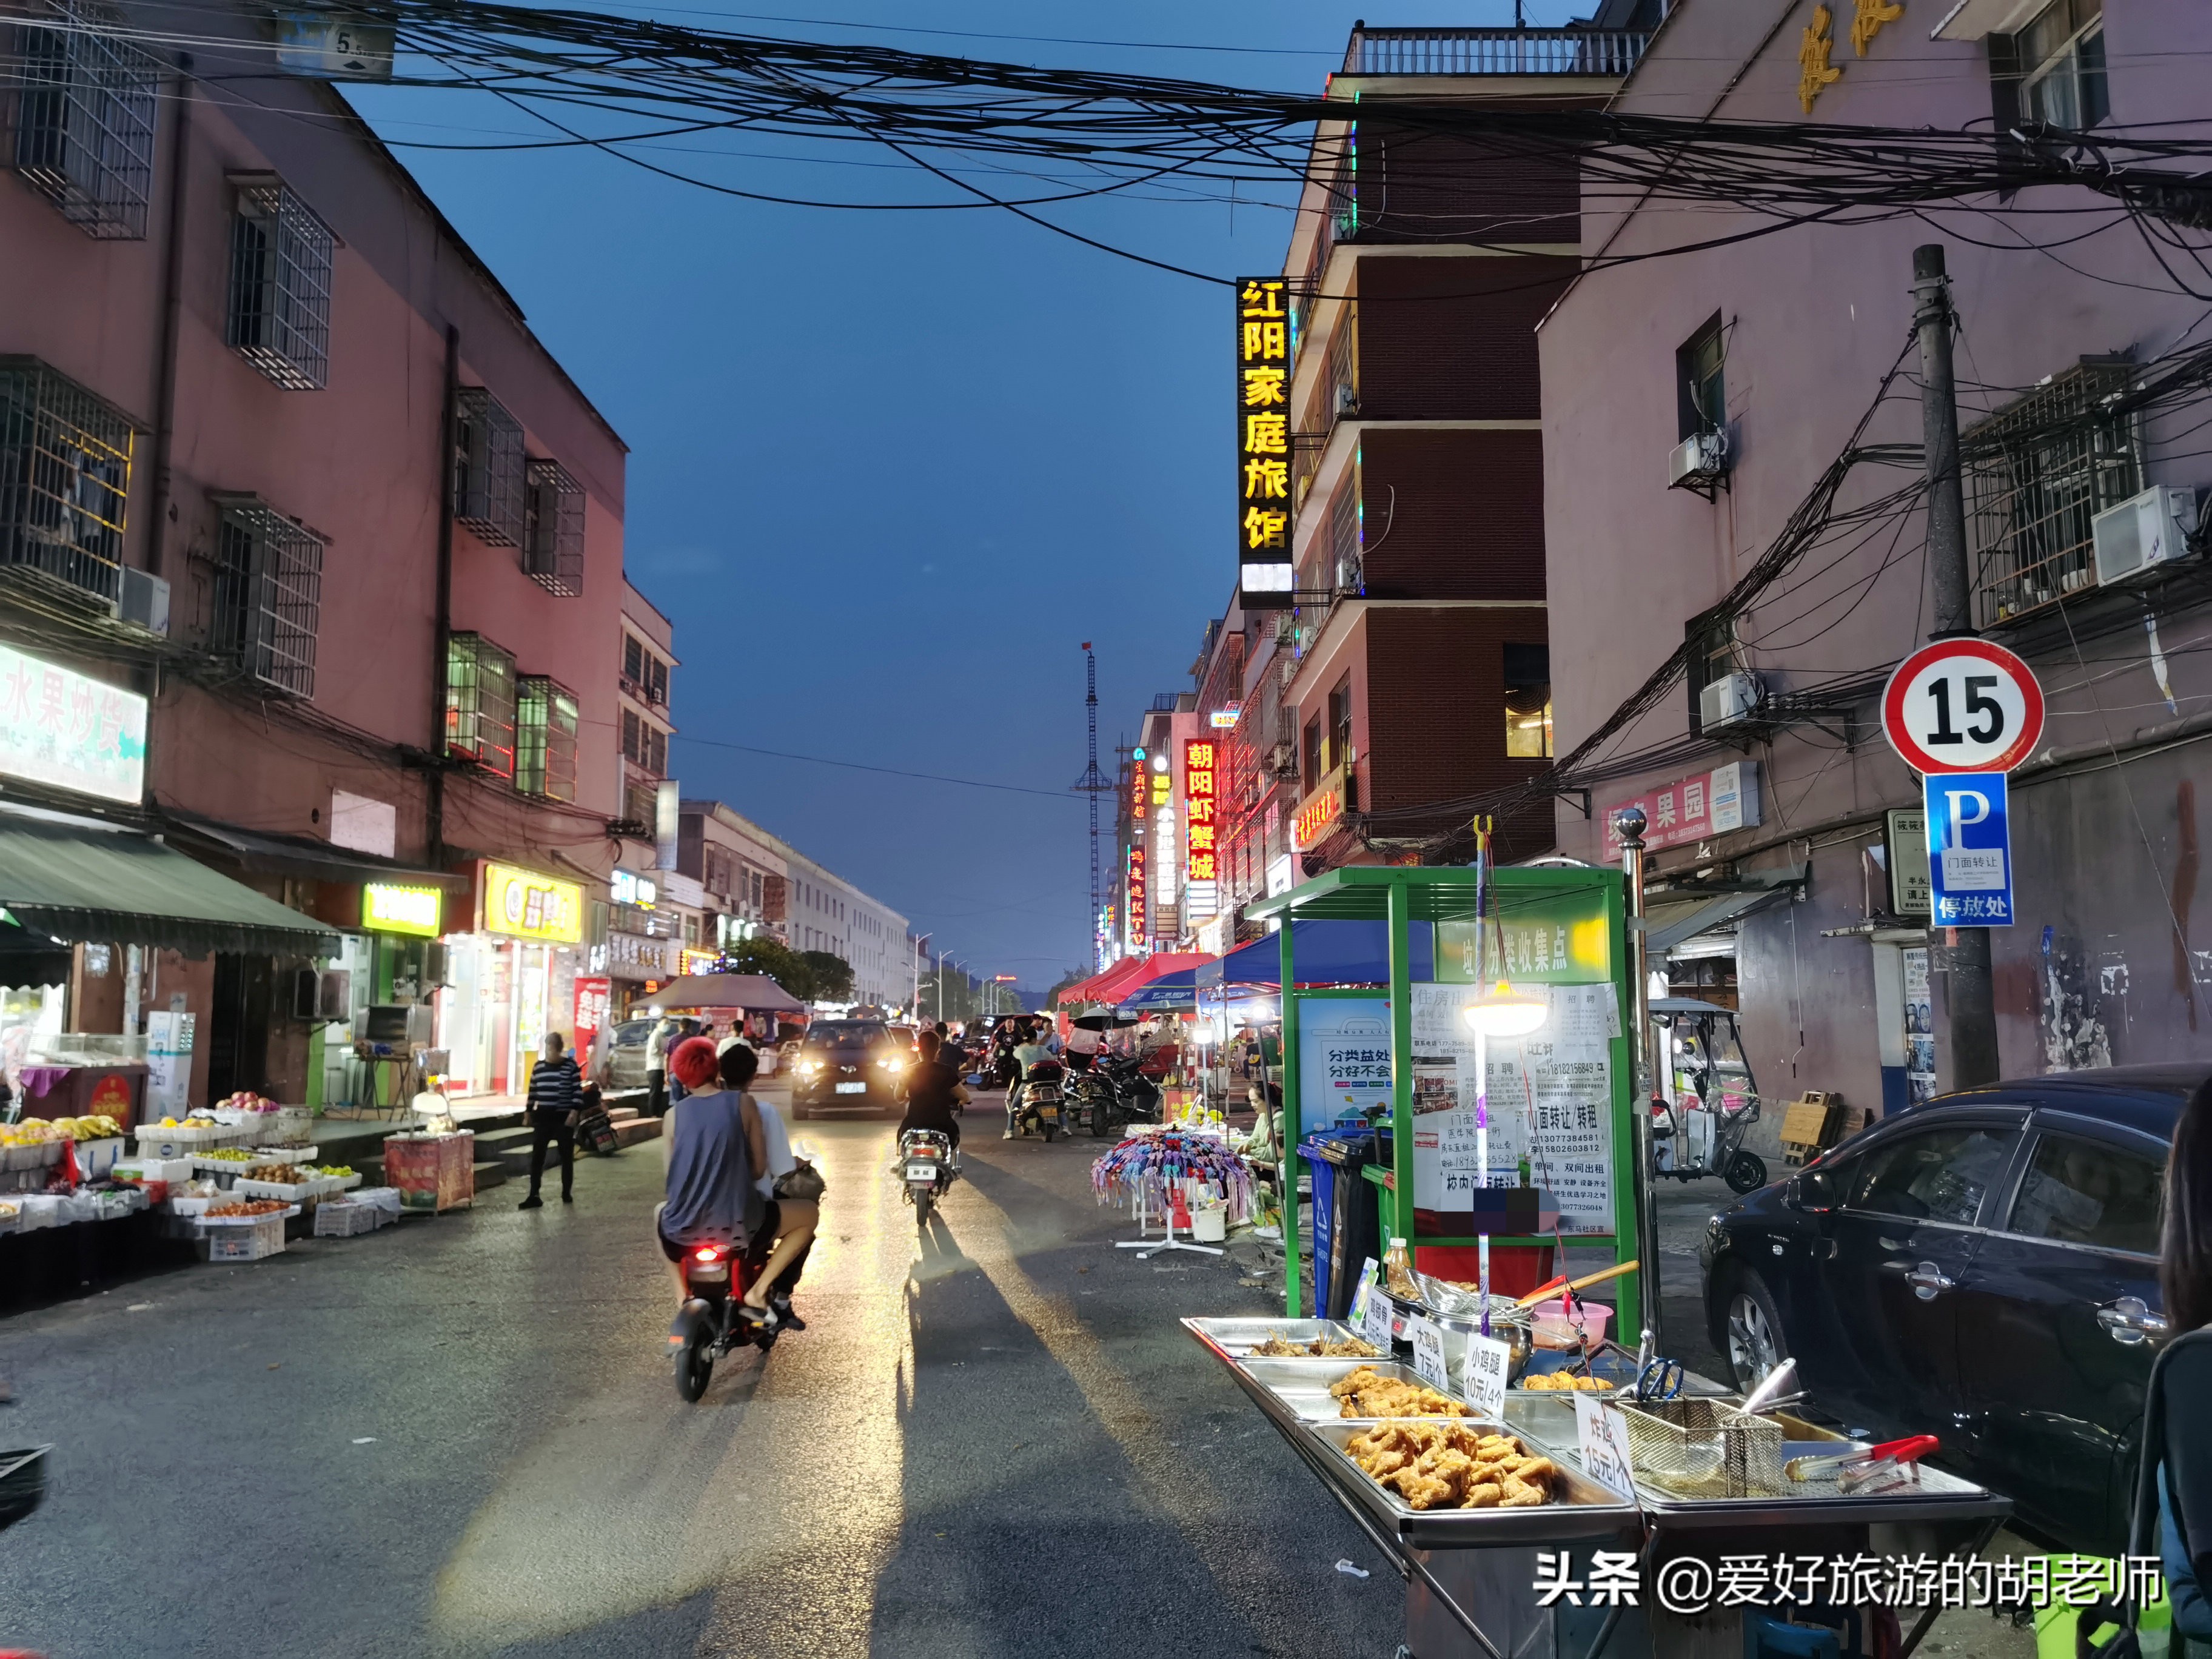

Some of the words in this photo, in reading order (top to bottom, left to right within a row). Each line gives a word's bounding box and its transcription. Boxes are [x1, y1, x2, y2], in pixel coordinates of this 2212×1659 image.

[1242, 280, 1288, 549] 红阳家庭旅馆
[5, 659, 123, 757] 水果炒货
[1927, 675, 2005, 746] 15
[1188, 743, 1215, 879] 朝阳虾蟹城
[1944, 789, 1991, 849] P
[1948, 856, 1998, 868] 门面转让
[1908, 876, 1930, 885] 半永
[1908, 890, 1929, 900] 请上
[1939, 896, 2008, 918] 停放处
[1463, 925, 1567, 975] 垃分类收集点
[1417, 989, 1466, 1006] 住房出
[1567, 995, 1595, 1004] 招聘
[1329, 1048, 1391, 1062] 分类益处
[1329, 1065, 1392, 1078] 分好不会
[1550, 1062, 1594, 1075] 18182156849
[1450, 1114, 1496, 1126] 门面租
[1528, 1104, 1598, 1130] 门面转让/转租
[1530, 1144, 1600, 1155] 李15802603812
[1534, 1162, 1605, 1175] 单间、双间出租
[1580, 1179, 1607, 1188] 设备齐全
[1548, 1190, 1607, 1199] 研生优选学习之地
[1567, 1225, 1605, 1233] 东马社区宣
[1416, 1326, 1440, 1358] 大鸡腿
[1472, 1346, 1501, 1376] 小鸡腿
[1590, 1412, 1614, 1444] 炸鸡
